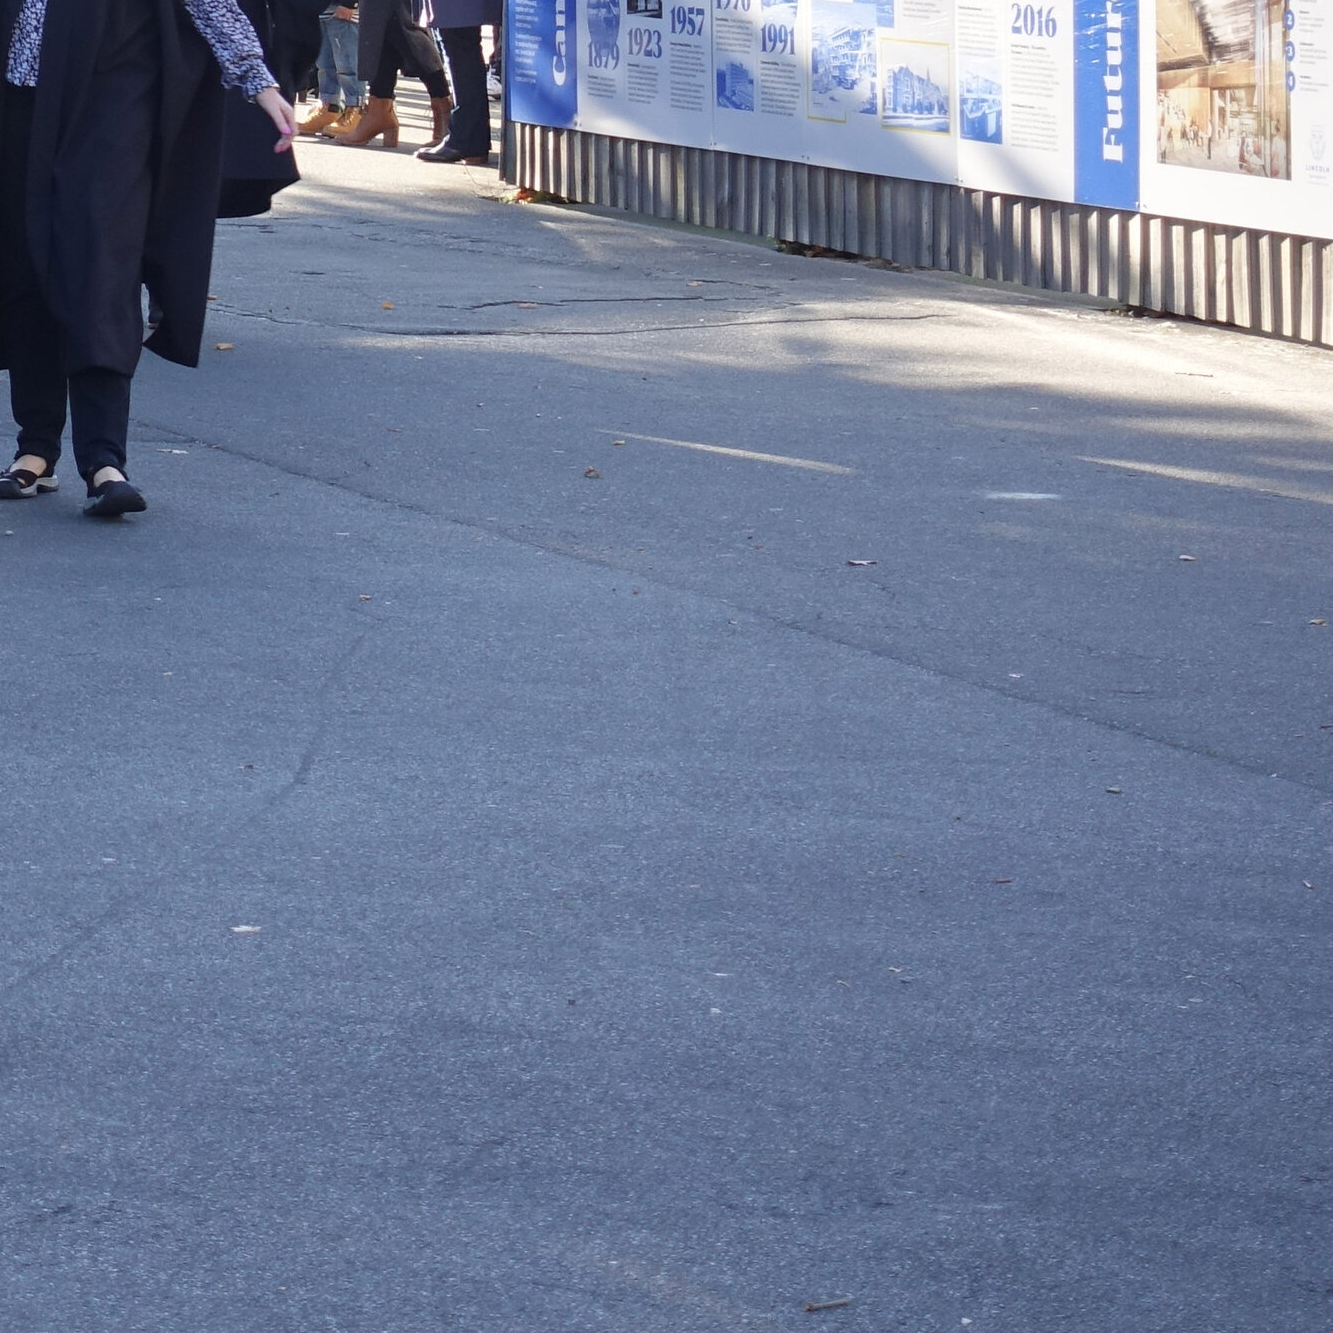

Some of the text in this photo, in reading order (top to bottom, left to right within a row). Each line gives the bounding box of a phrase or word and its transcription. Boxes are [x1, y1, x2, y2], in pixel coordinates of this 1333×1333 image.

[670, 5, 705, 37] 1957
[1011, 2, 1057, 39] 2016
[627, 27, 663, 59] 1923
[760, 23, 797, 55] 1991
